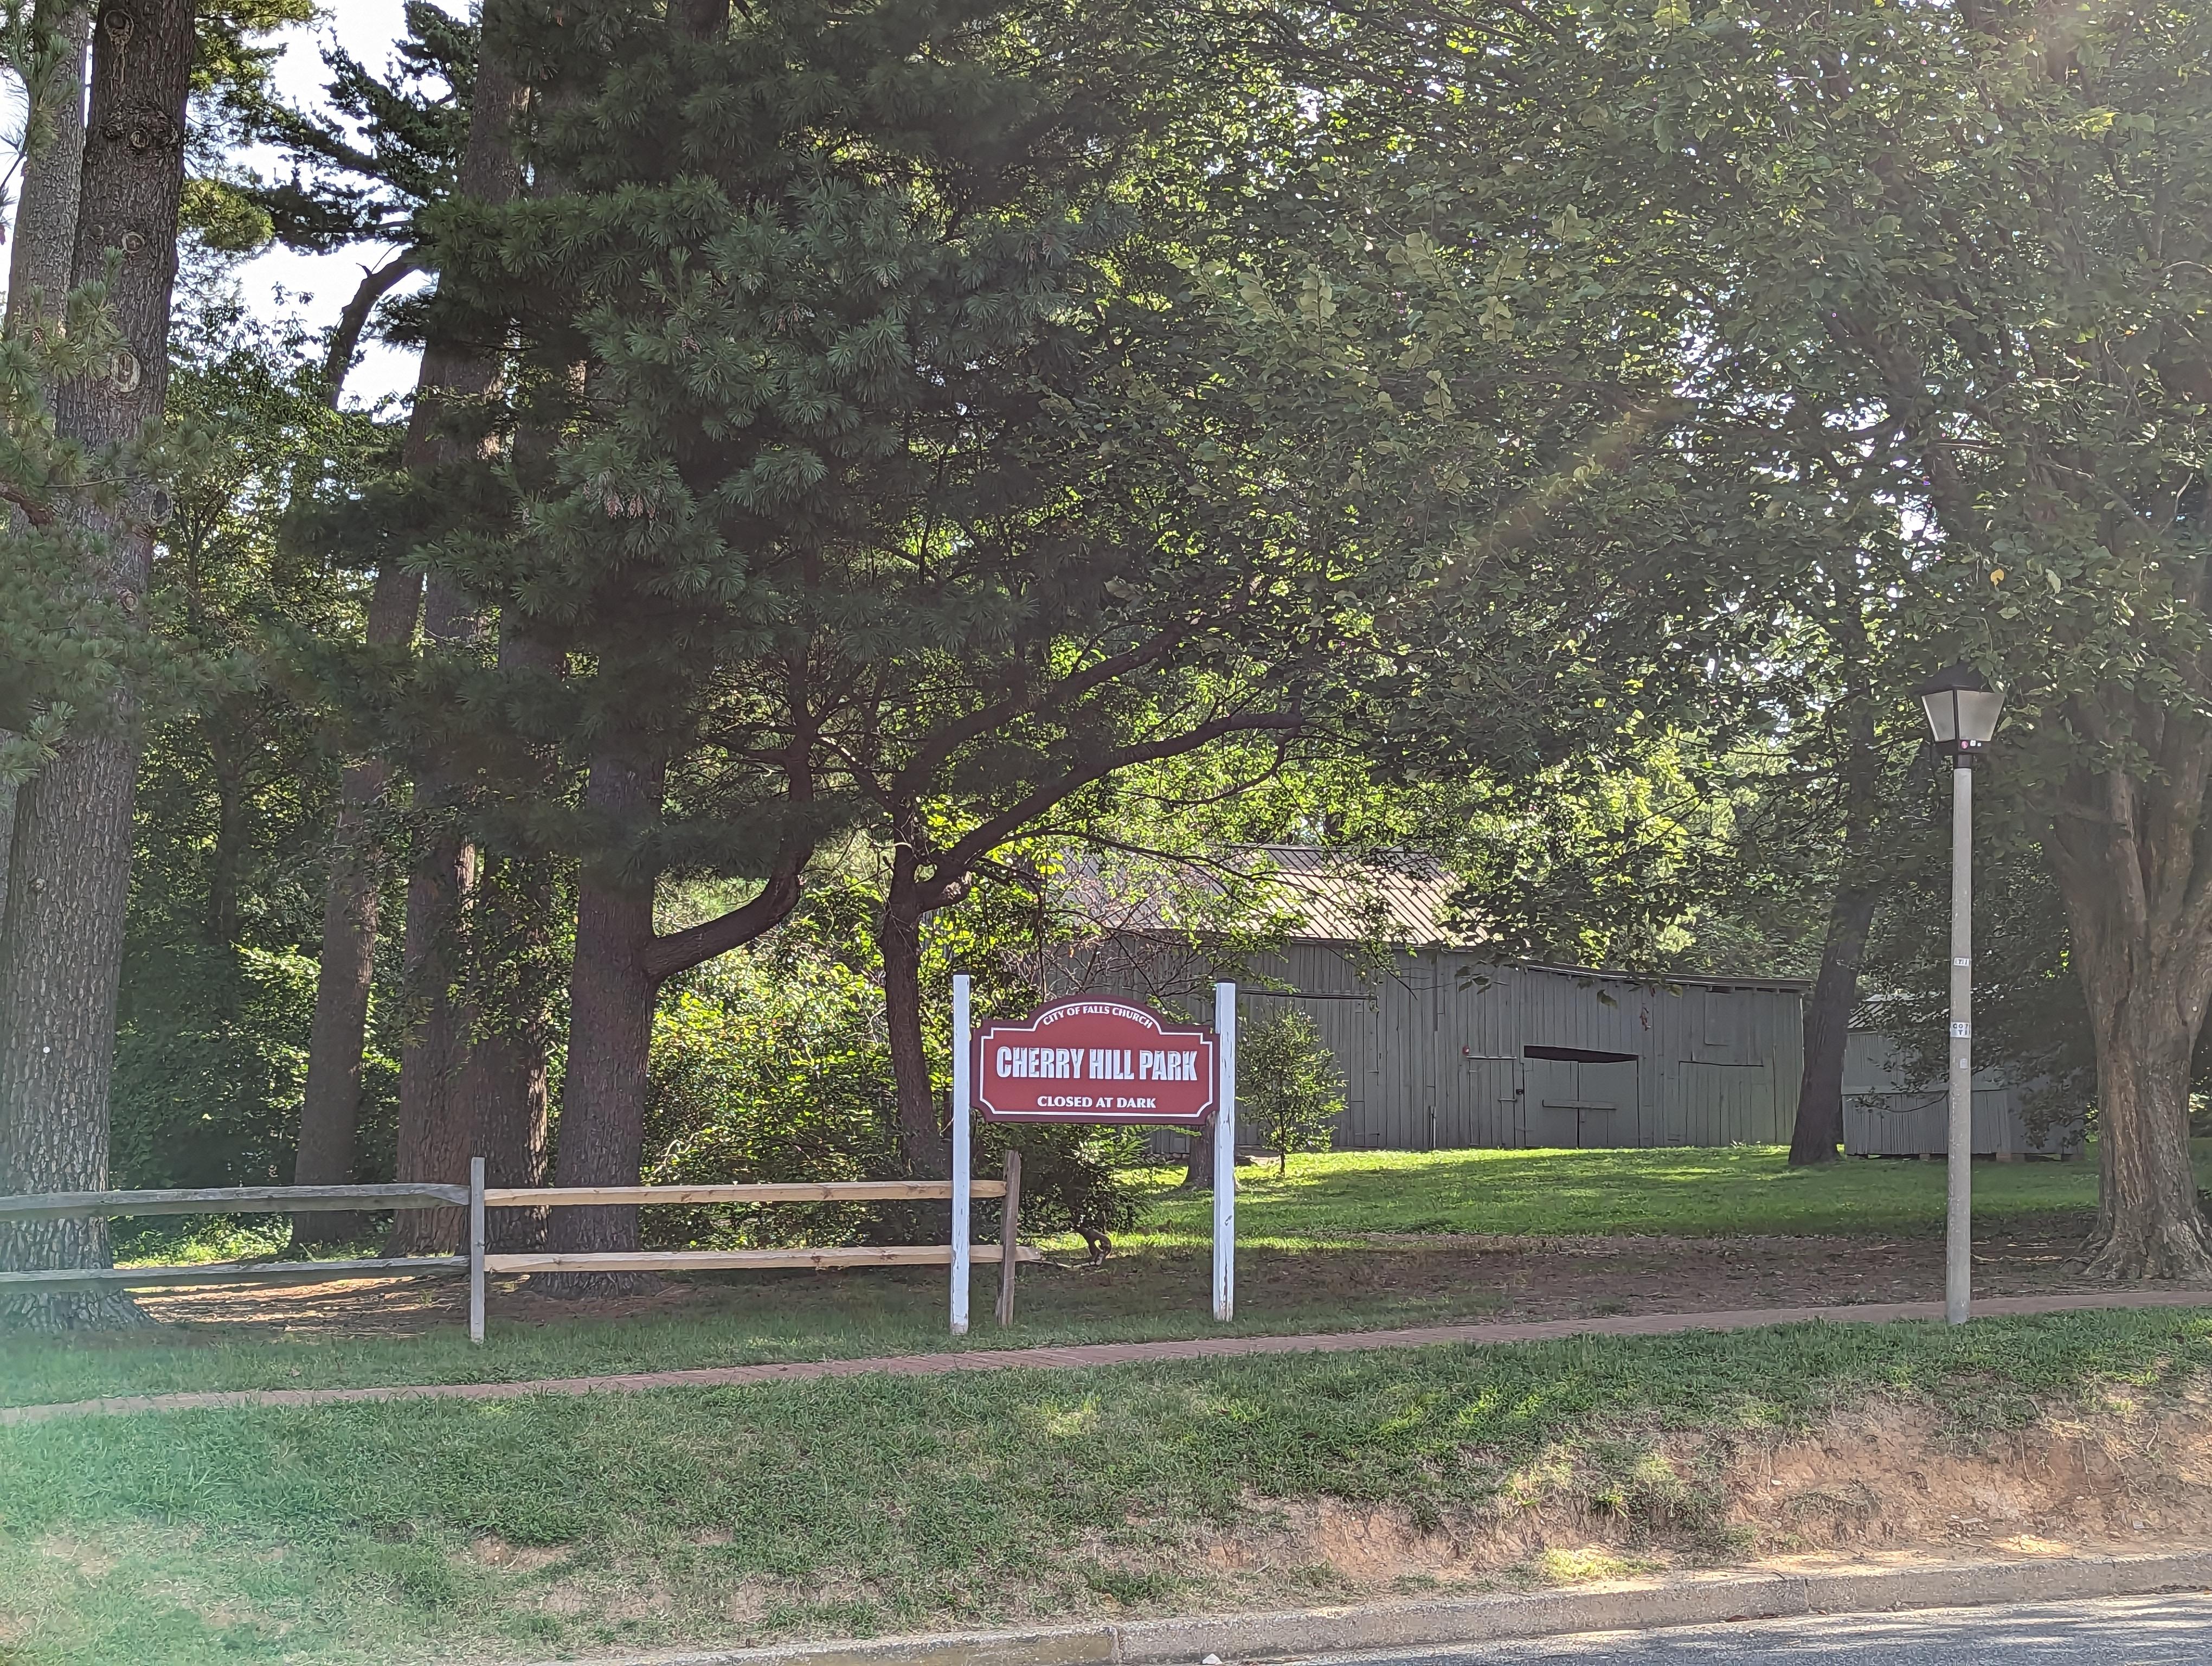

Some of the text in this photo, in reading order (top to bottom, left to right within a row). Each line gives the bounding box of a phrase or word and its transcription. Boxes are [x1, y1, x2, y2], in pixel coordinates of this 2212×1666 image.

[1043, 1005, 1153, 1029] CITY OF FALLS CHURCH
[996, 1046, 1198, 1081] CHERRY HILL PARK
[1037, 1095, 1156, 1108] CLOSED AT DARK
